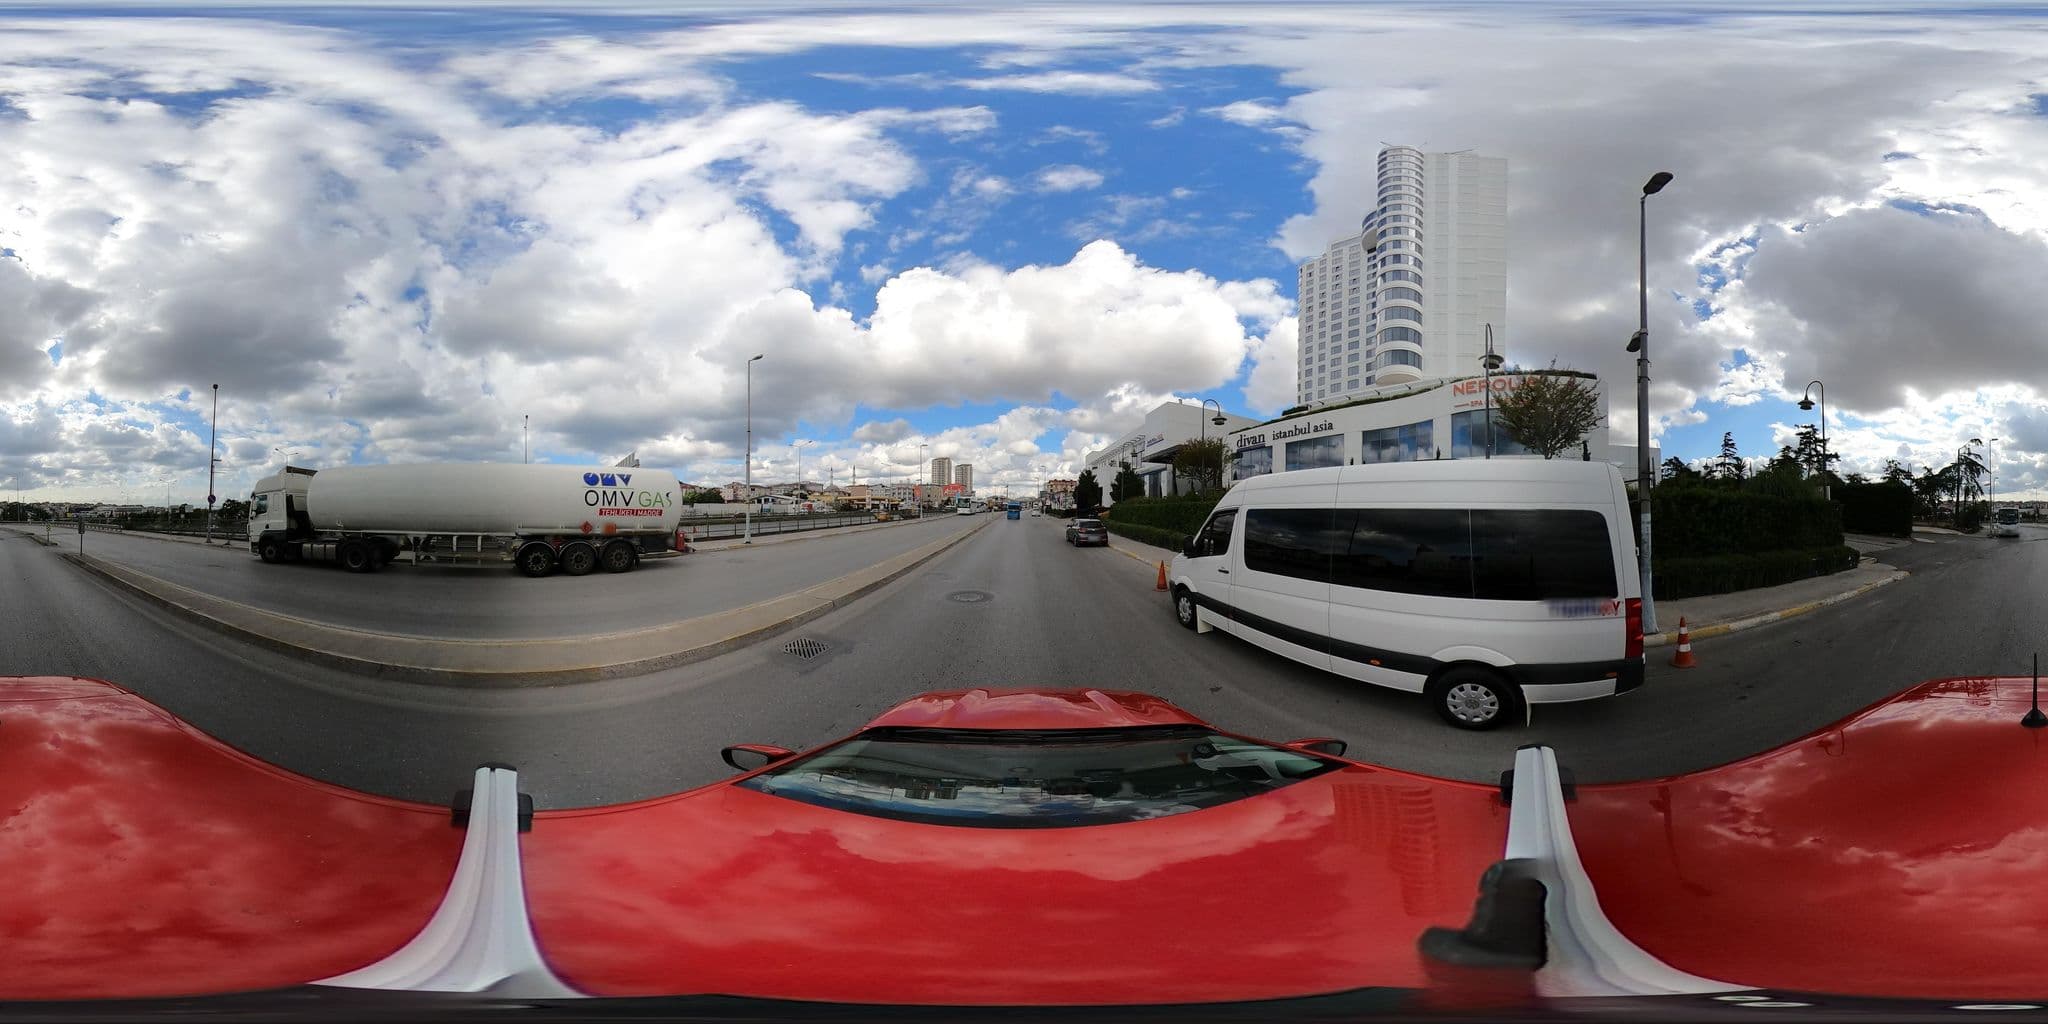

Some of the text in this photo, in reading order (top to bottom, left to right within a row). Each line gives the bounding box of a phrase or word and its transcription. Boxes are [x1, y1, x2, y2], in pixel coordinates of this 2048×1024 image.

[1236, 420, 1334, 448] divan istanbul asia
[584, 490, 673, 508] OMV GAS
[637, 509, 662, 517] MADDE
